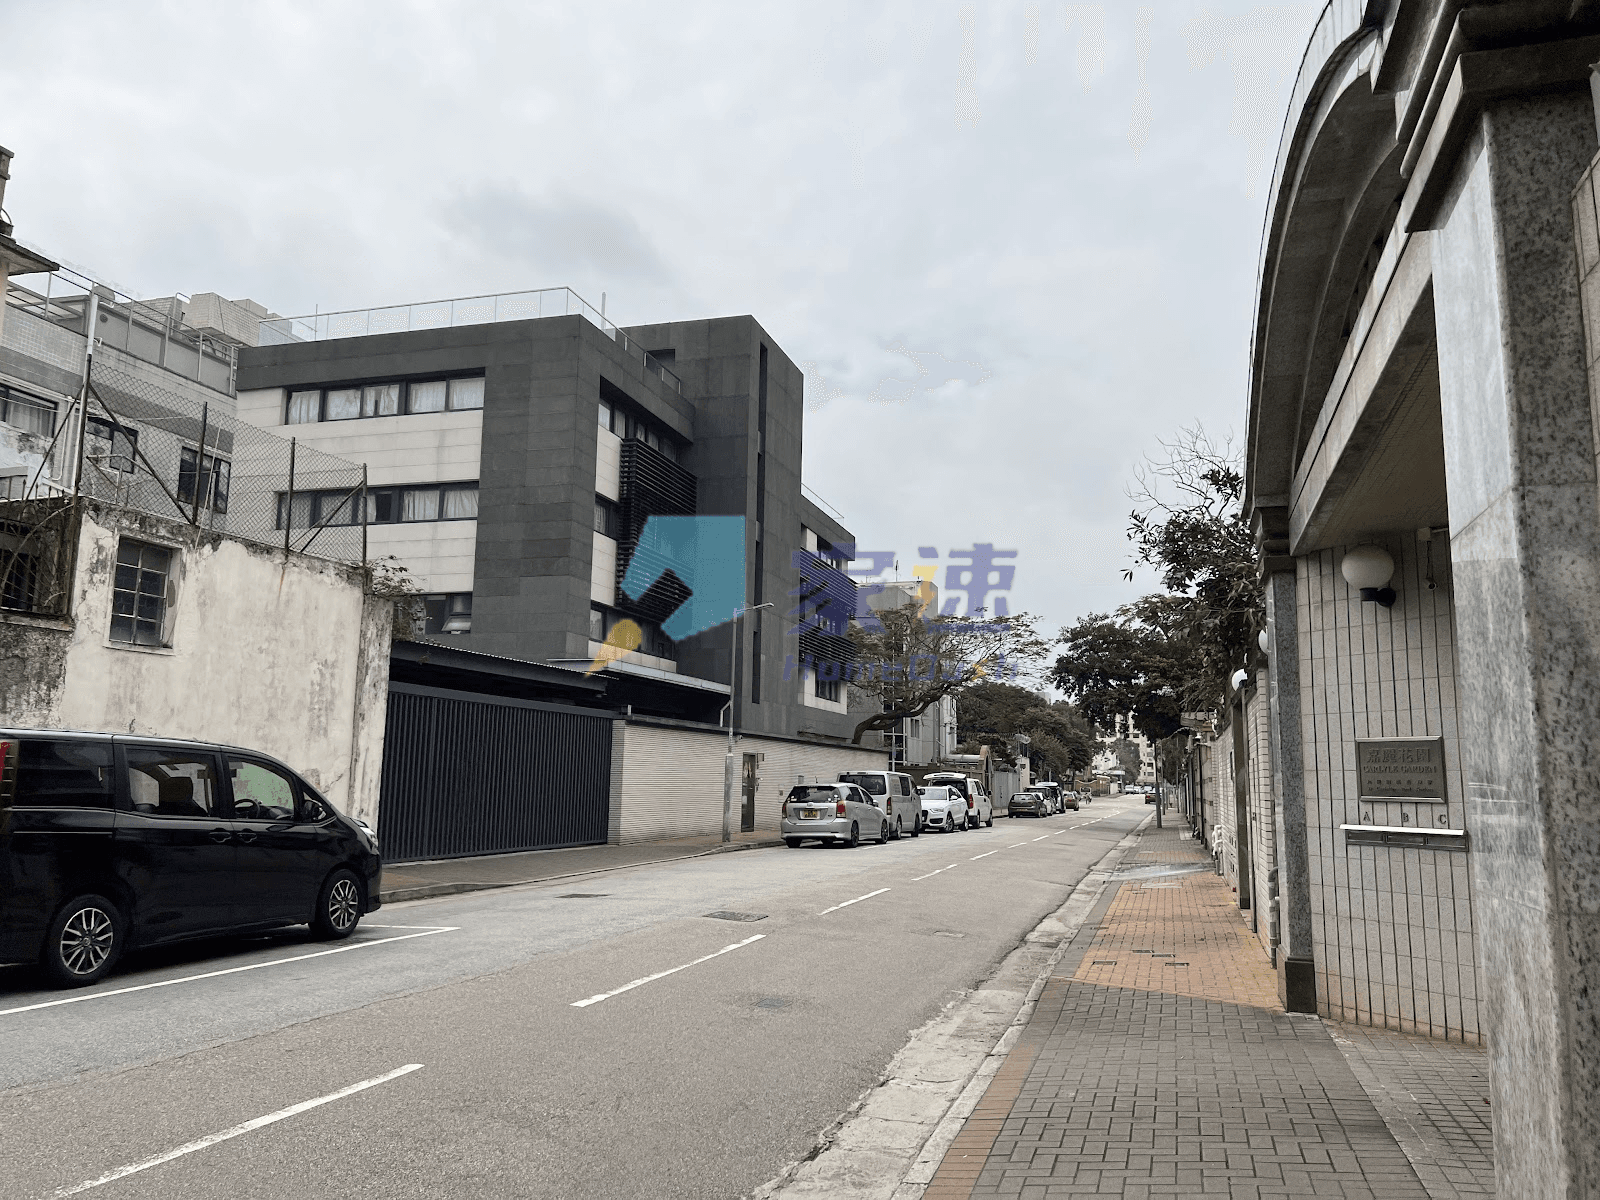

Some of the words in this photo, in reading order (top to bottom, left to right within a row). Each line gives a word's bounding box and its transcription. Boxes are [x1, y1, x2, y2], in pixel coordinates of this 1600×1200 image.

[1363, 811, 1371, 822] A
[1402, 812, 1409, 823] B
[1437, 814, 1447, 825] C
